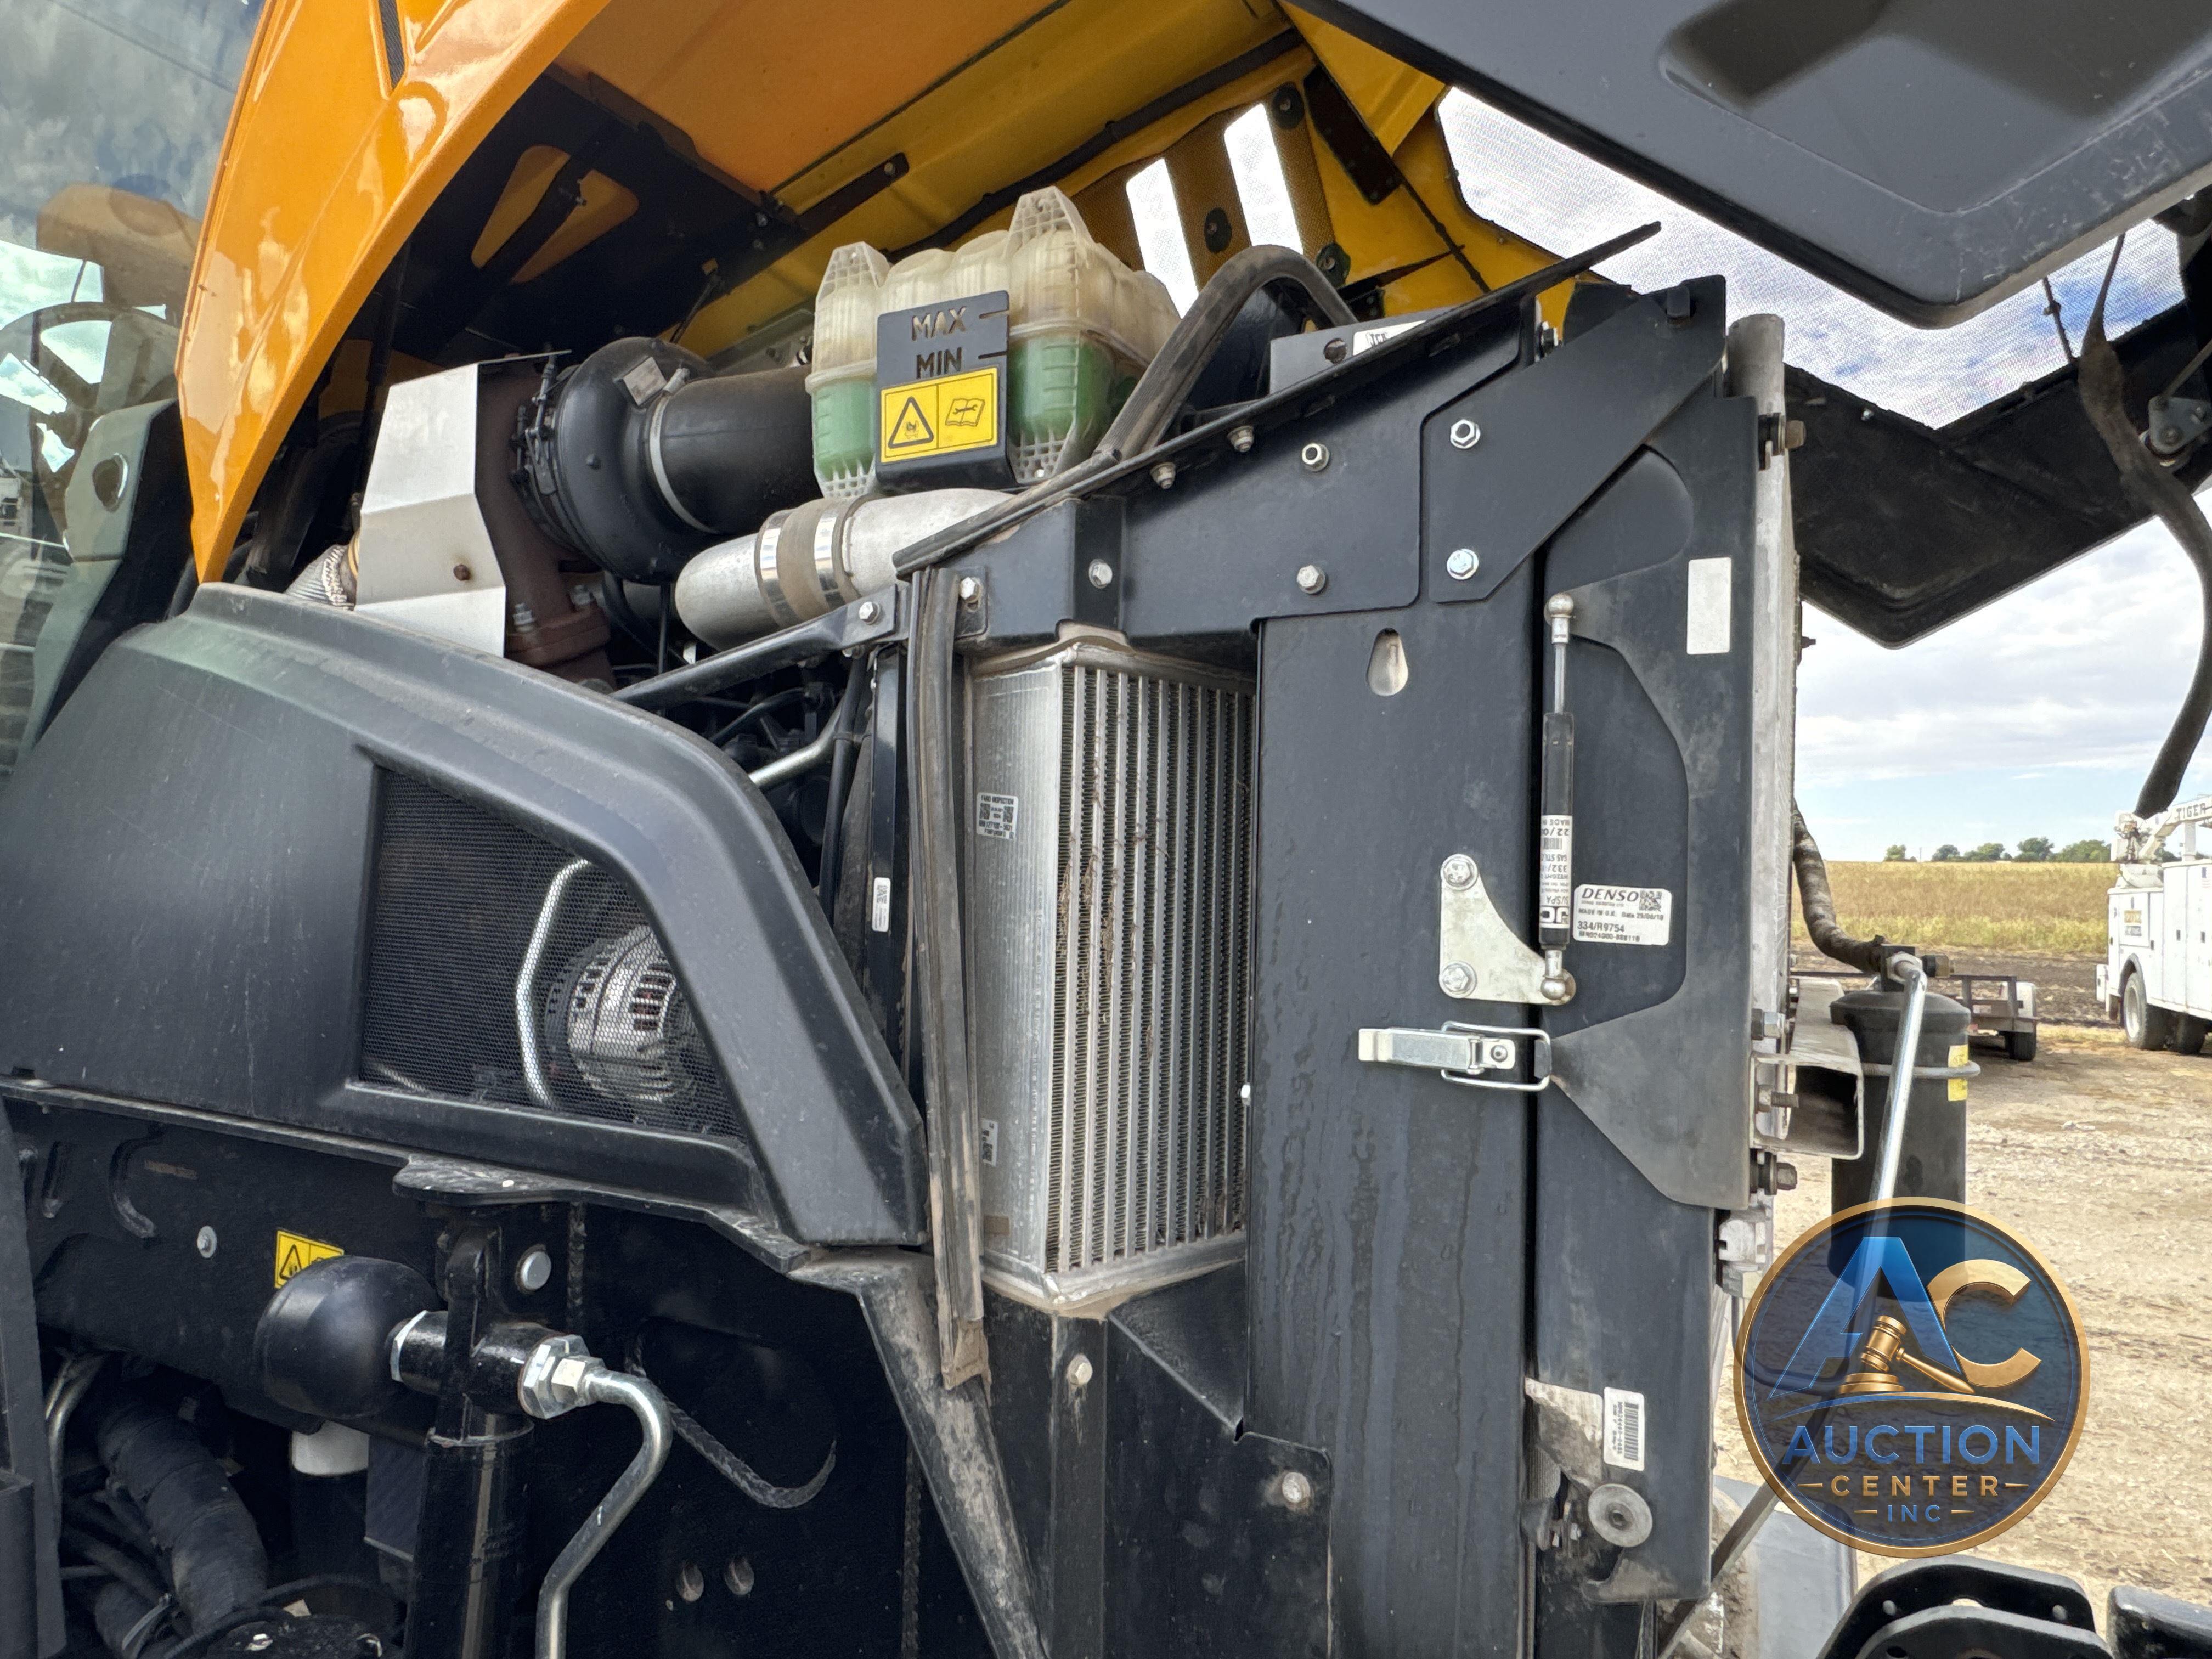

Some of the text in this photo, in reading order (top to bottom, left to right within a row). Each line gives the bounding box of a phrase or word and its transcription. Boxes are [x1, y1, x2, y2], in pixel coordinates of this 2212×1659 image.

[911, 307, 967, 341] MAX
[916, 347, 962, 379] MIN
[2176, 803, 2205, 820] TIGER
[1582, 888, 1639, 902] DENSO
[1577, 921, 1624, 932] 334/R9754
